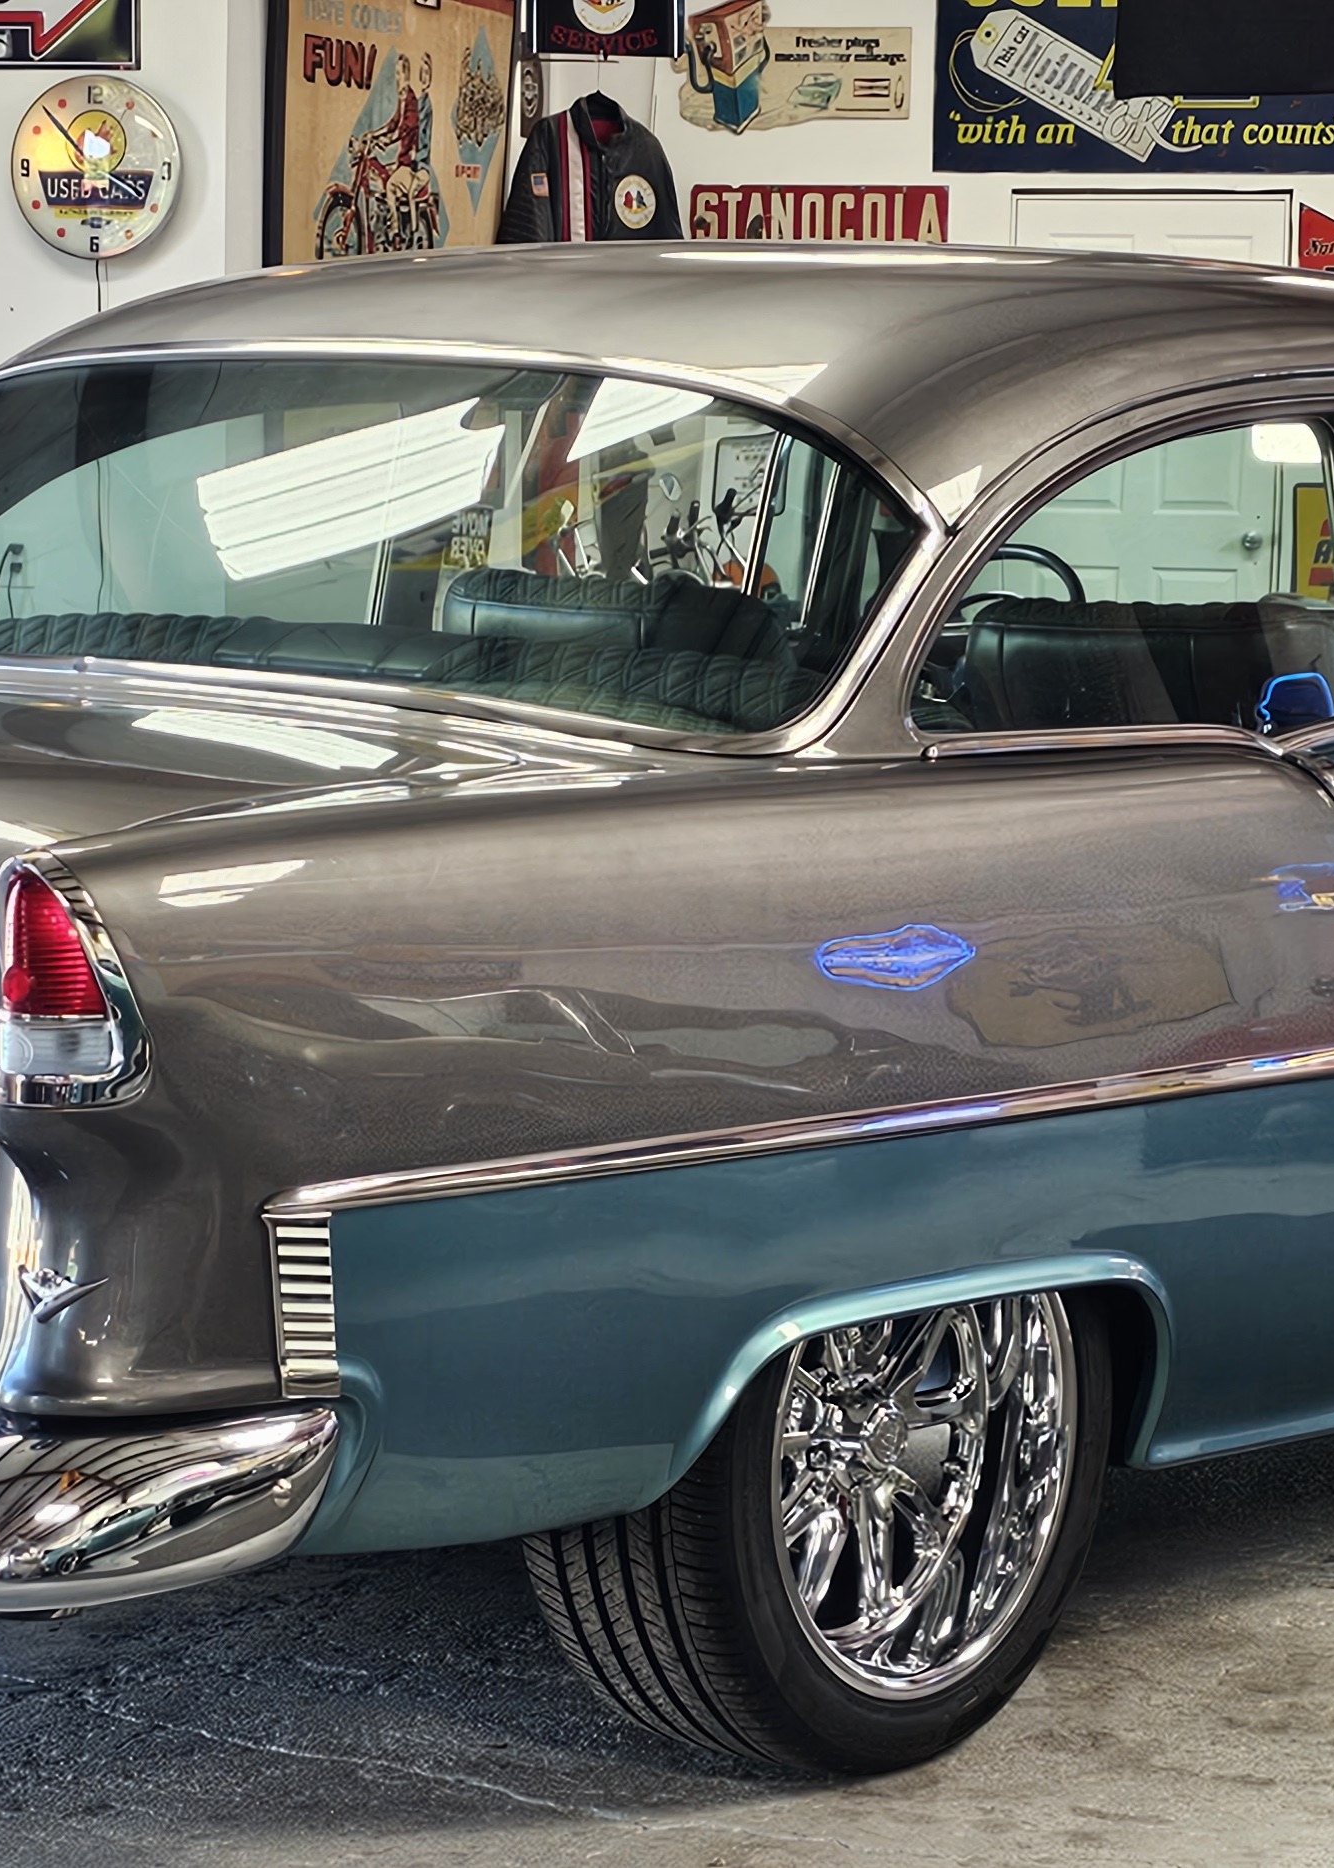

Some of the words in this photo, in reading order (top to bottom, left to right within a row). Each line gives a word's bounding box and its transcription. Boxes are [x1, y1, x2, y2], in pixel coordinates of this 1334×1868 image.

[550, 25, 658, 56] SERVICE
[994, 46, 1017, 68] This
[1014, 26, 1030, 45] car
[303, 33, 378, 90] FUN!
[87, 86, 103, 104] 12
[1035, 122, 1076, 145] an
[1102, 98, 1204, 153] OK
[1171, 116, 1234, 145] that
[21, 159, 30, 177] 9
[47, 178, 91, 199] USED
[695, 192, 943, 242] STANOCOLA
[90, 236, 99, 252] 6
